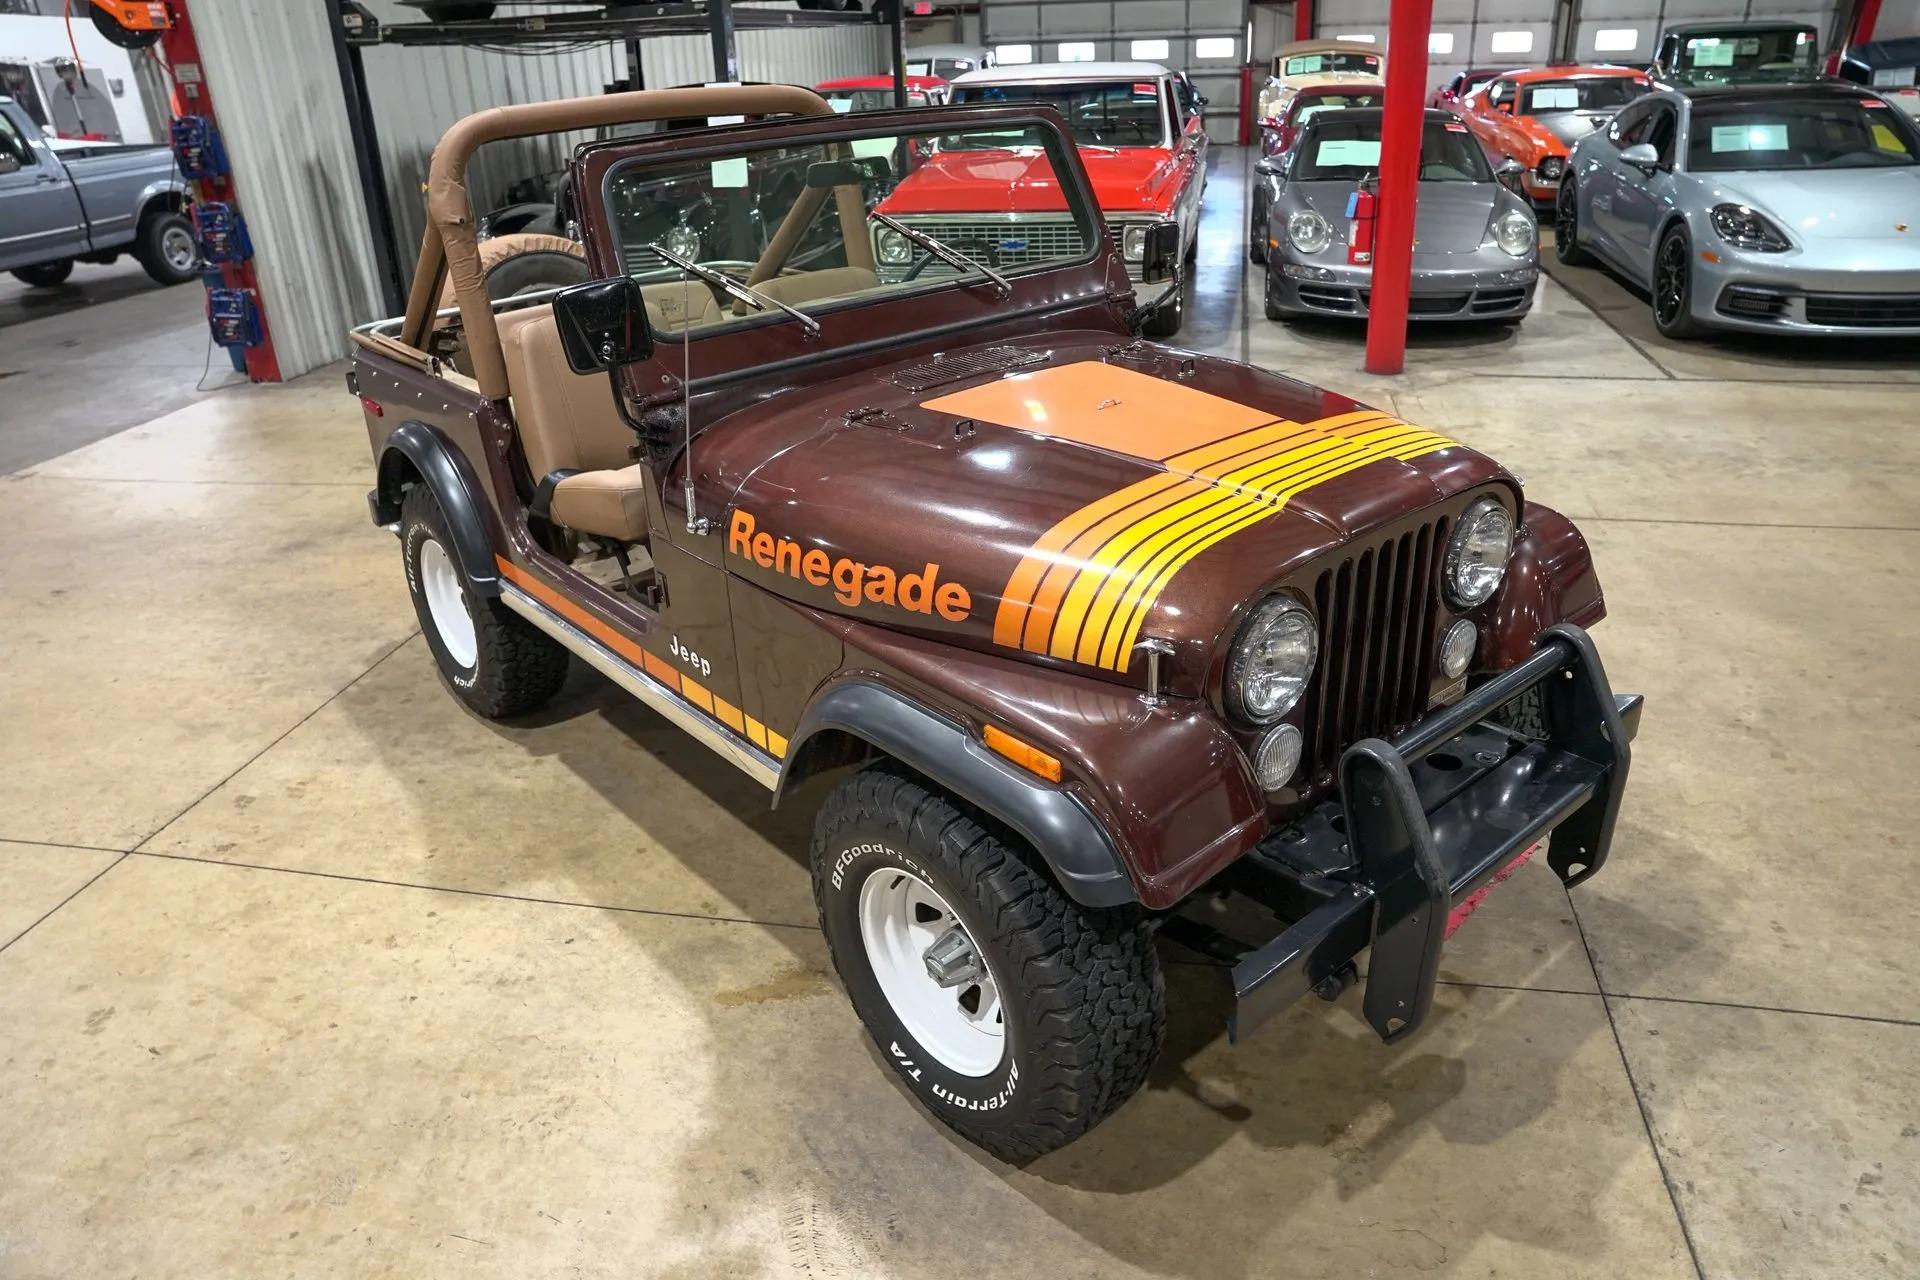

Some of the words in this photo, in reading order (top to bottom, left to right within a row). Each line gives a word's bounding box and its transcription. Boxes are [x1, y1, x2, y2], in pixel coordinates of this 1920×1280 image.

[728, 508, 972, 622] Renegade
[669, 634, 713, 678] Jeep
[831, 843, 934, 891] BFGoodrich
[890, 1040, 923, 1082] T/A
[932, 1057, 1019, 1111] All-Terrain
